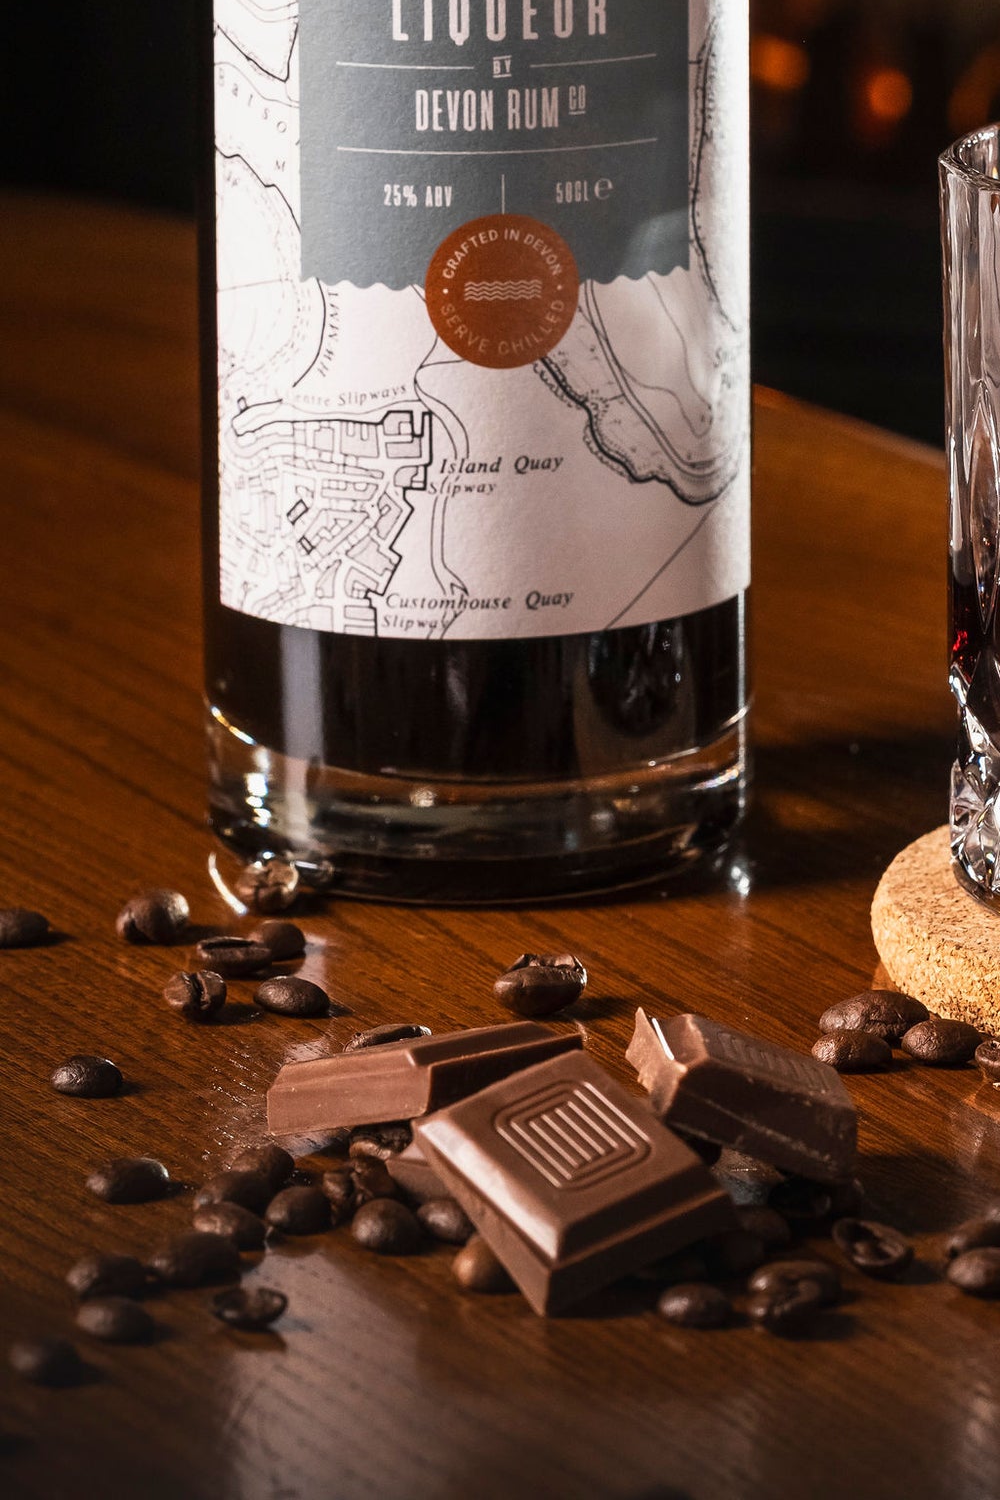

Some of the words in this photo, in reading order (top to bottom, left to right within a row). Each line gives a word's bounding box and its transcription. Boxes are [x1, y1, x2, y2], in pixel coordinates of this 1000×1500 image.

[493, 58, 511, 76] BY
[415, 89, 494, 132] DEVON
[507, 86, 559, 130] RUM
[568, 84, 587, 112] CO
[383, 183, 417, 208] 25%
[425, 185, 452, 208] ABV
[442, 228, 499, 279] CRAFTED
[504, 228, 520, 242] IN
[523, 233, 562, 276] DEVON
[441, 303, 491, 353] SERVE
[497, 299, 565, 355] CHILLED
[337, 384, 407, 407] Slipways
[439, 456, 502, 474] Island
[514, 455, 564, 475] Quay
[428, 478, 497, 498] Slipway
[385, 593, 511, 610] Customhouse
[525, 589, 575, 611] Quay
